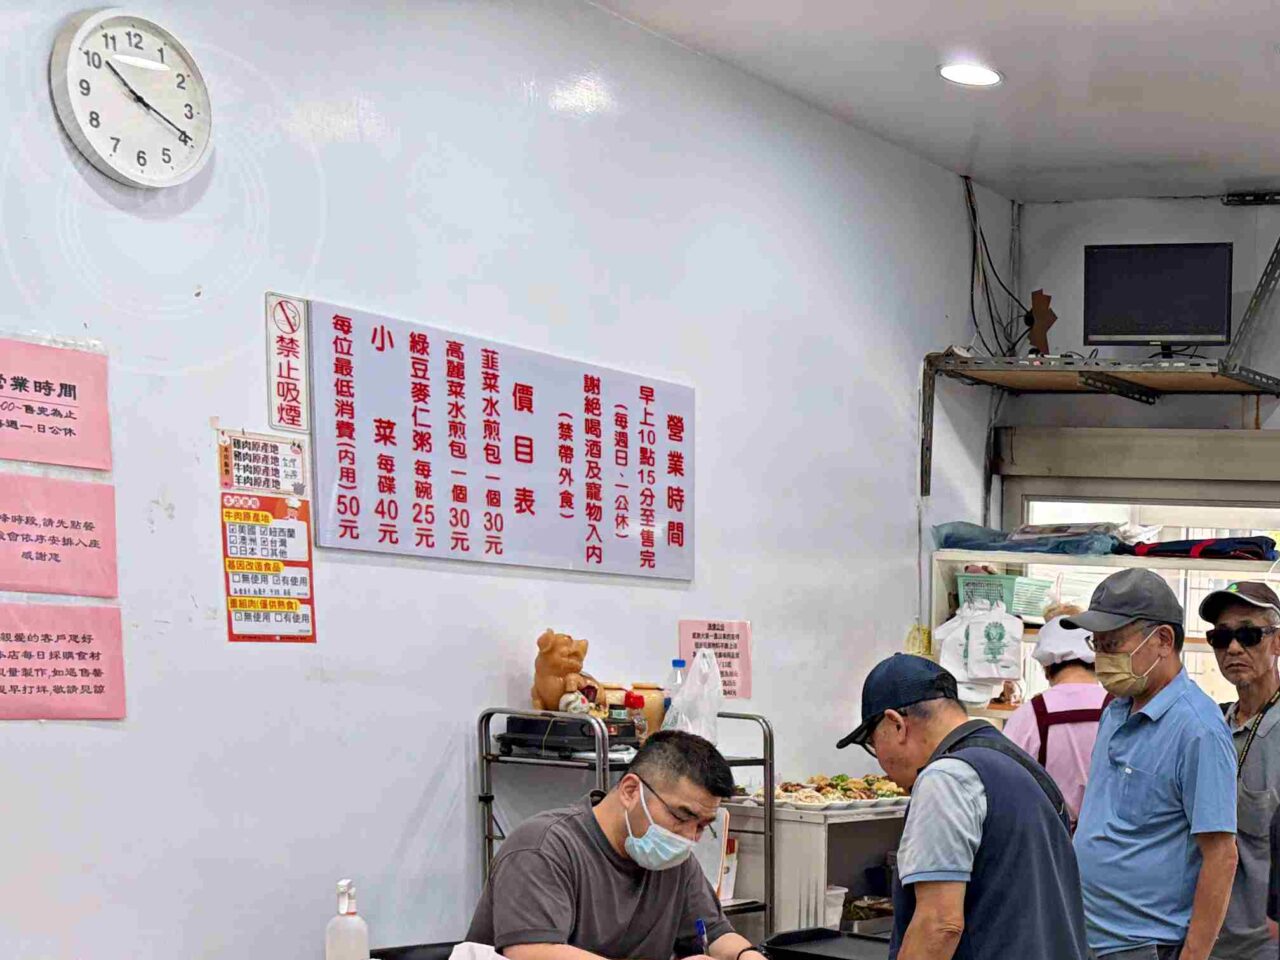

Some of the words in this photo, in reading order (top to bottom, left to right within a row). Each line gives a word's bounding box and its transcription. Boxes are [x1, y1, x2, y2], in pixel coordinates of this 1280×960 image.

[102, 33, 117, 52] 11
[125, 31, 144, 50] 12
[83, 50, 102, 69] 10
[157, 47, 165, 63] 1
[79, 79, 91, 96] 9
[175, 73, 187, 90] 2
[89, 111, 100, 128] 8
[183, 103, 194, 120] 3
[110, 137, 121, 153] 7
[137, 150, 147, 166] 6
[162, 148, 172, 164] 5
[276, 335, 302, 427] 禁止吸煙
[667, 414, 684, 547] 營業時間
